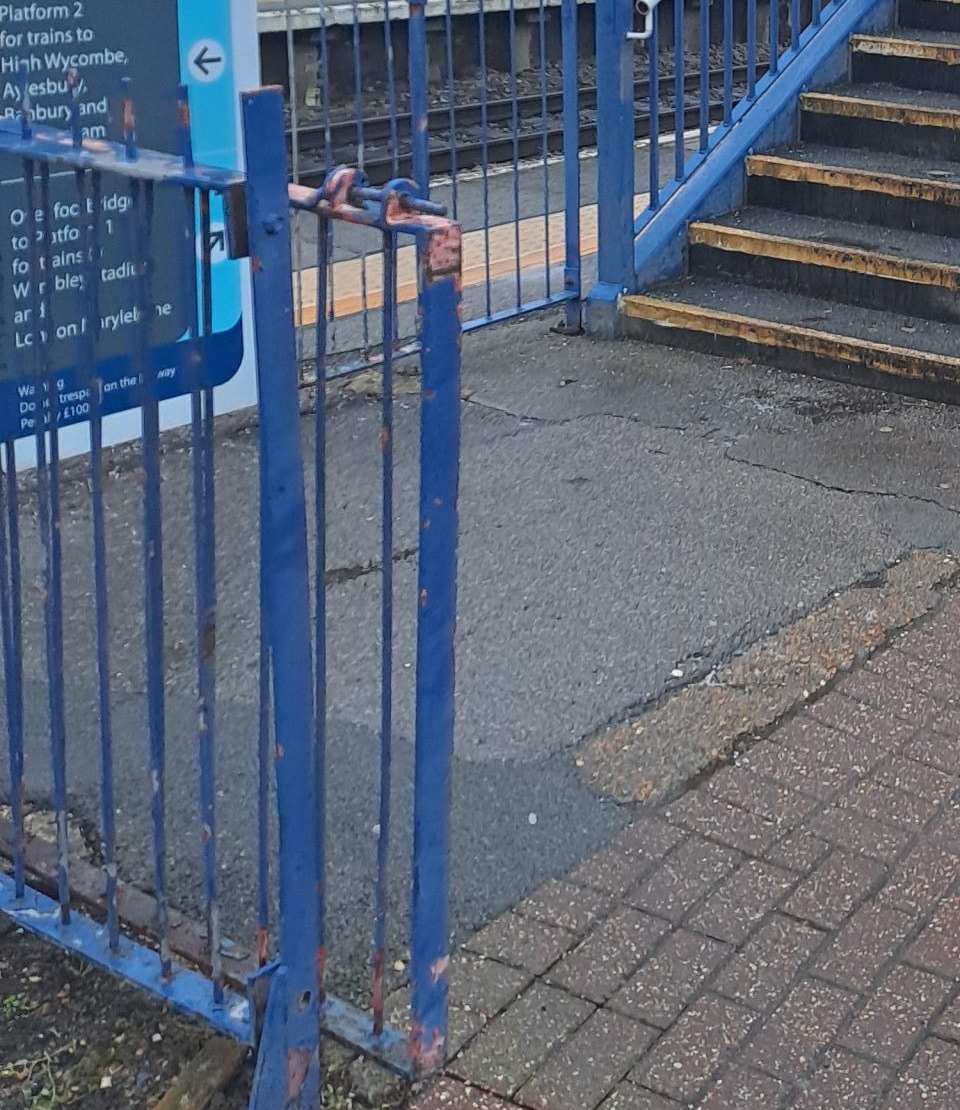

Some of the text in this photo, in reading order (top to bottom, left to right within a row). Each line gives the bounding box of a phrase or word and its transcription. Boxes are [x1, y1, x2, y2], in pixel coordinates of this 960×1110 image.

[0, 1, 83, 21] Platform 2
[0, 27, 93, 47] for trains to
[44, 47, 129, 71] Wycombe,
[79, 96, 107, 115] and
[12, 236, 28, 250] to
[105, 218, 112, 234] 1
[12, 258, 33, 275] fo
[39, 250, 84, 270] tains
[20, 402, 36, 414] Do
[103, 382, 117, 392] on
[120, 376, 137, 388] the
[64, 402, 89, 419] £100
